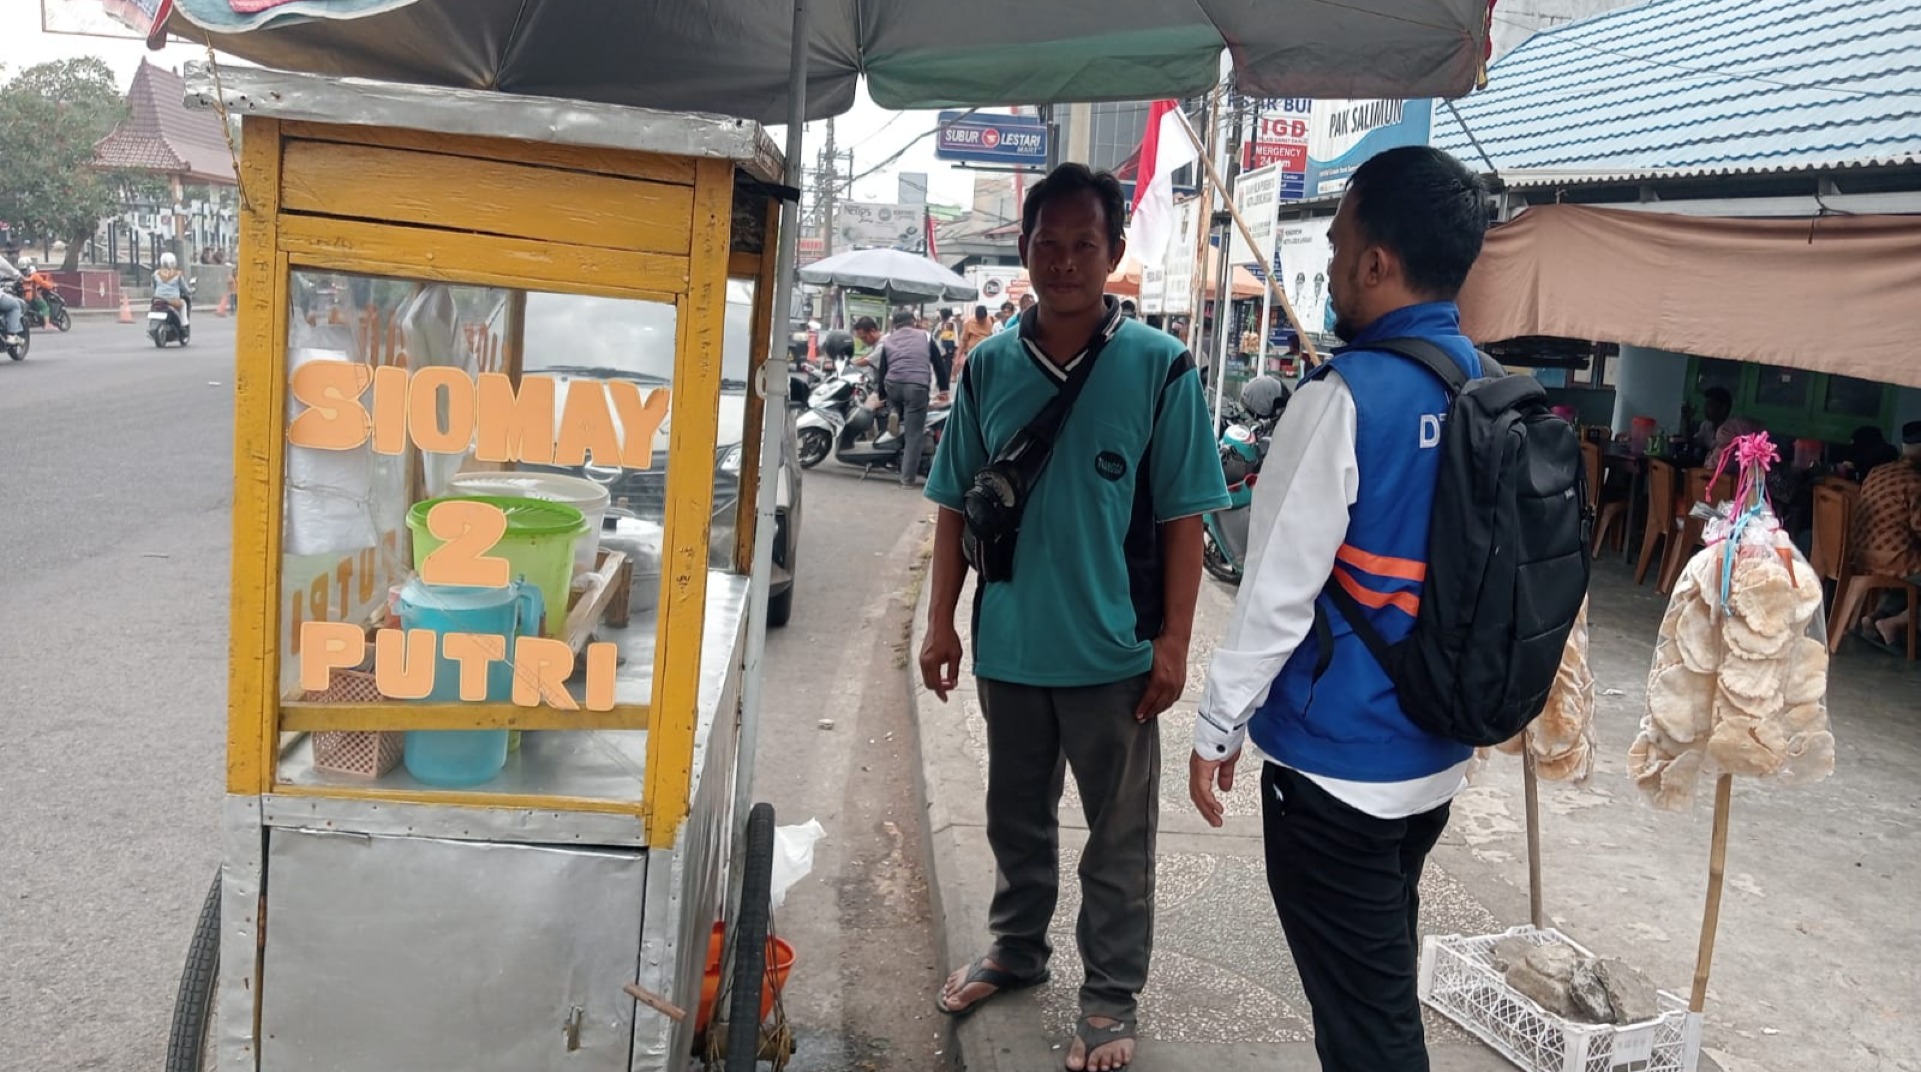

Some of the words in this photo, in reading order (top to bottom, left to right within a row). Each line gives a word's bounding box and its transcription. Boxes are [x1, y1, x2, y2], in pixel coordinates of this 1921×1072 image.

[1262, 118, 1306, 138] IGD
[1329, 109, 1350, 138] PAK
[1351, 97, 1403, 133] SALIMUN
[945, 129, 980, 143] SUBUR
[1001, 132, 1041, 147] LESTARI
[1255, 146, 1302, 157] MERGENCY
[1260, 155, 1271, 166] 24
[287, 359, 672, 470] SIOMAY
[420, 500, 511, 589] 2
[300, 621, 618, 712] PUTRI
